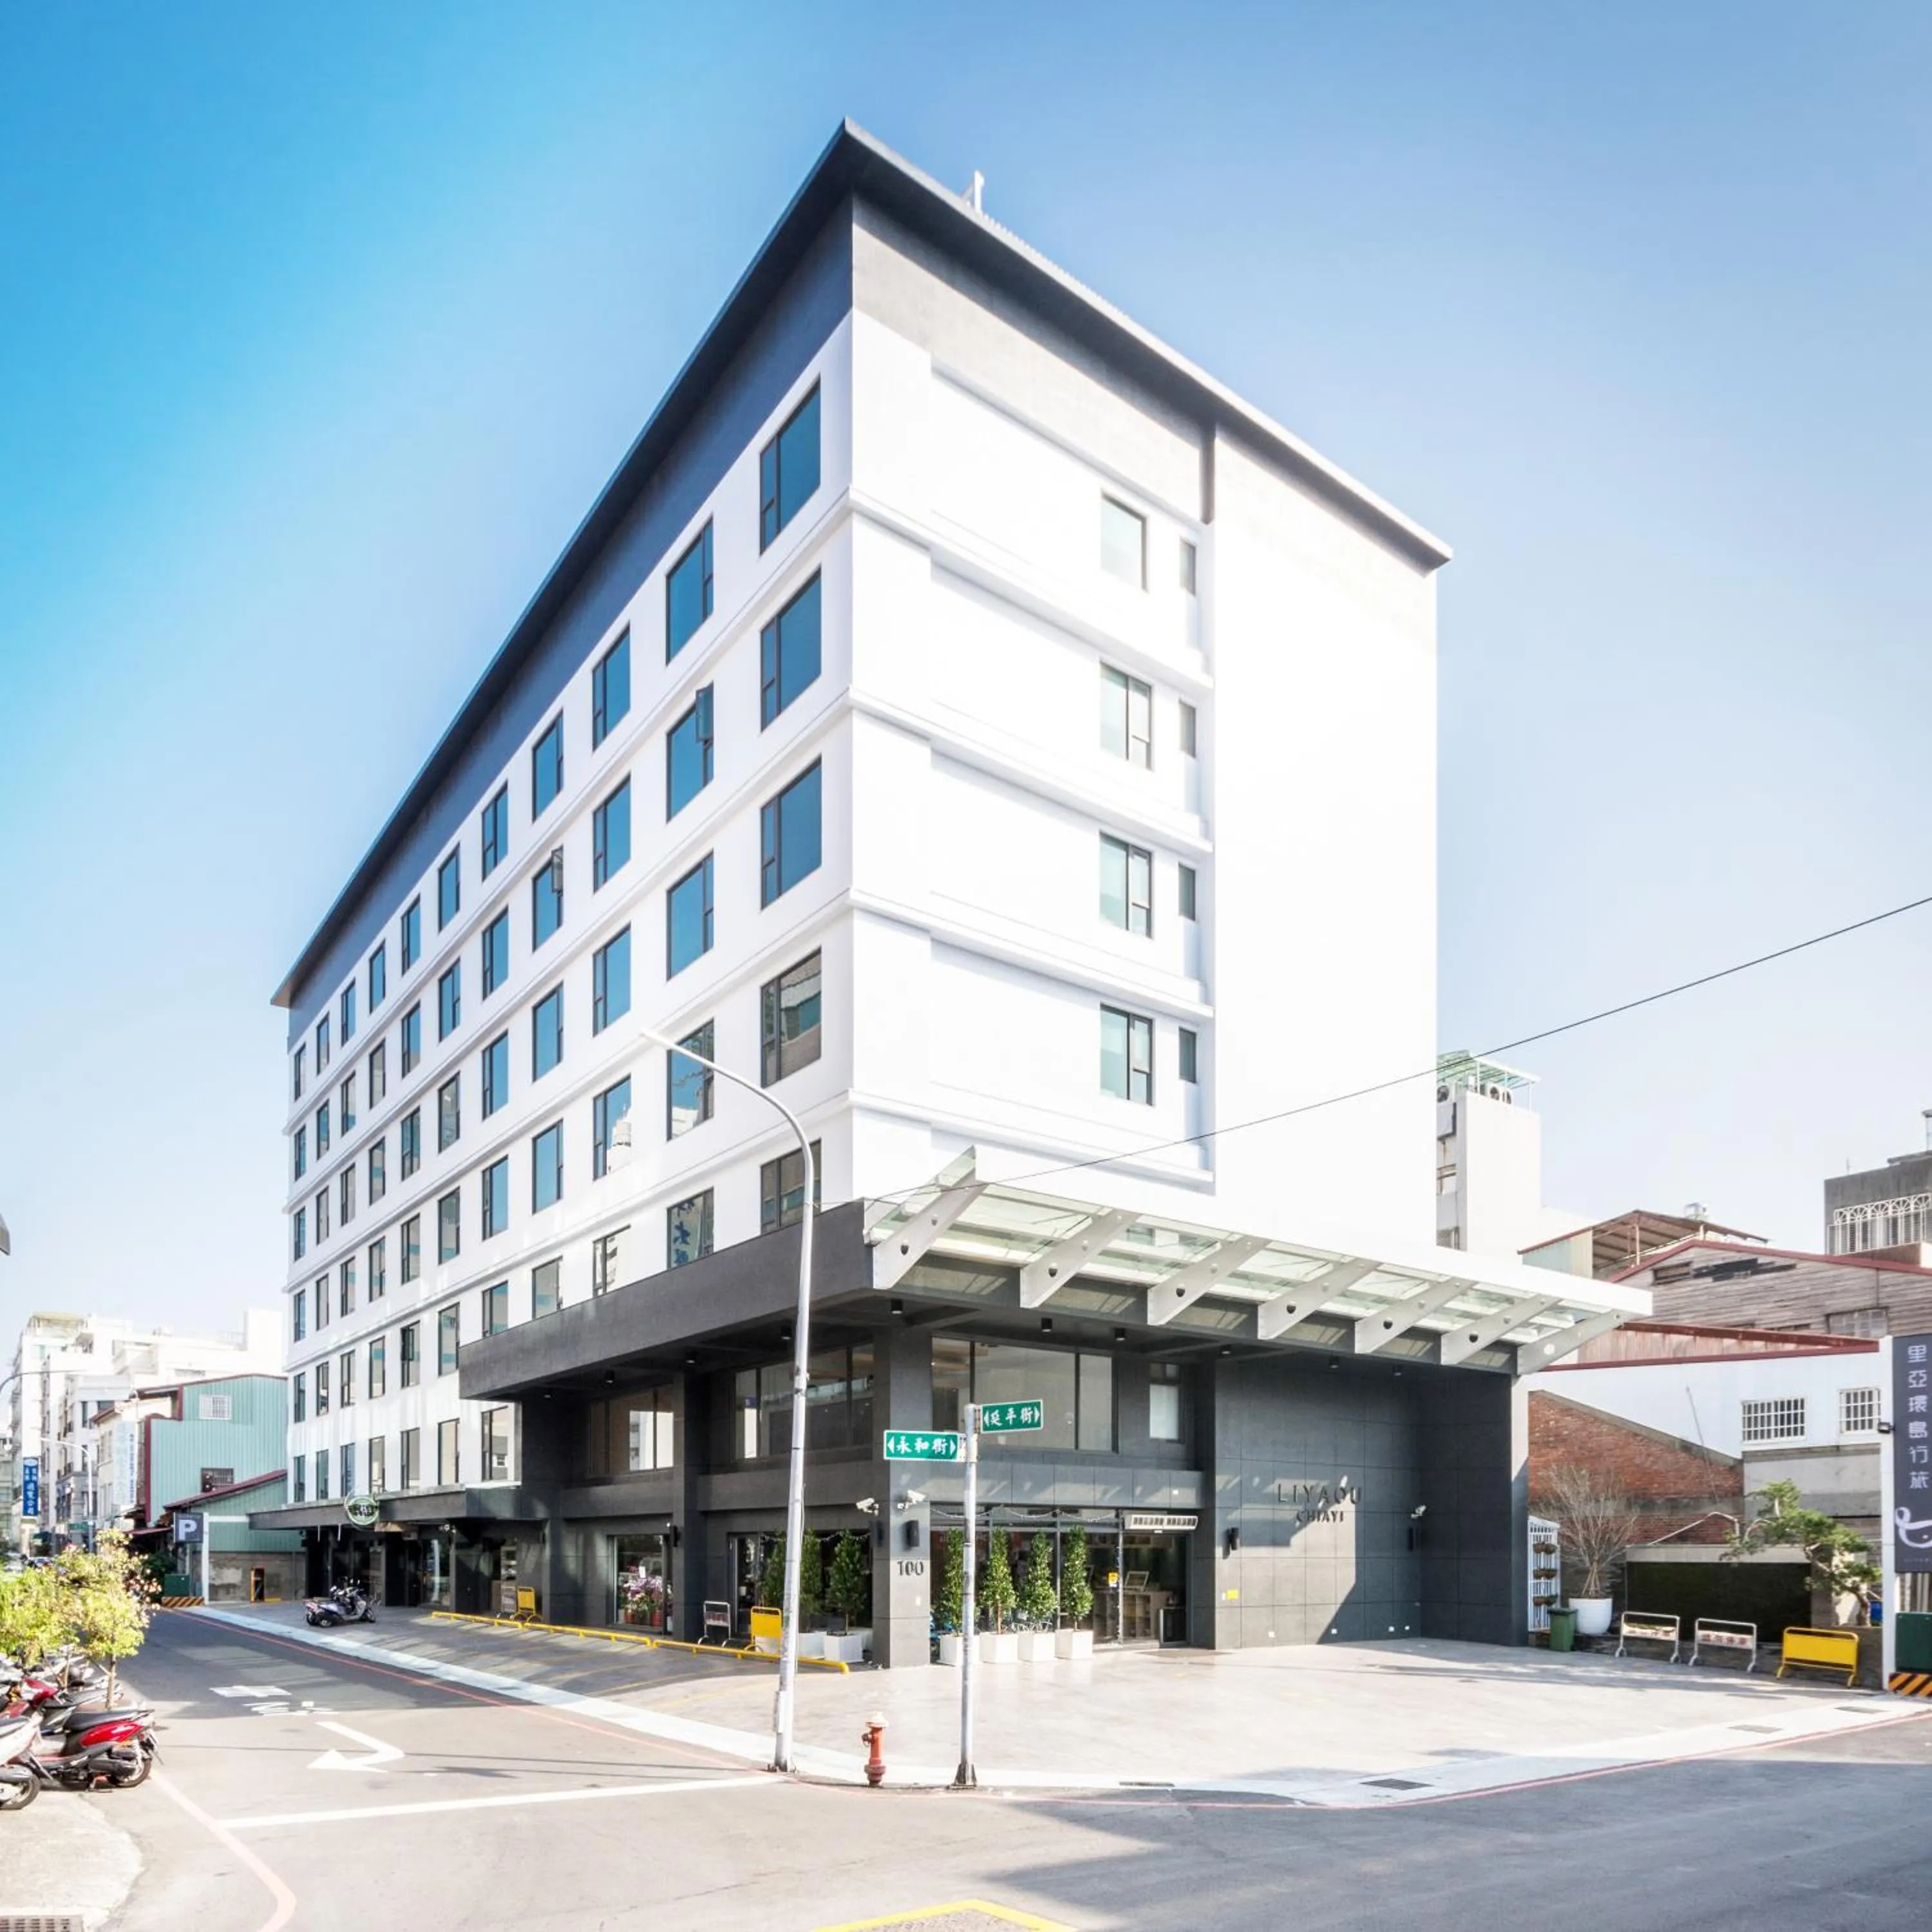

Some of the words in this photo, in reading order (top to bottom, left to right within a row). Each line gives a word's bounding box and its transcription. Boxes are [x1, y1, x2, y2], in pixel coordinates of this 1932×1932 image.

[990, 1406, 1034, 1426] 延平街
[1907, 1344, 1929, 1490] 里亞環島行旅
[896, 1435, 949, 1455] 永和街
[1296, 1510, 1344, 1522] CHIAYI
[179, 1519, 197, 1540] P
[897, 1560, 924, 1576] 100
